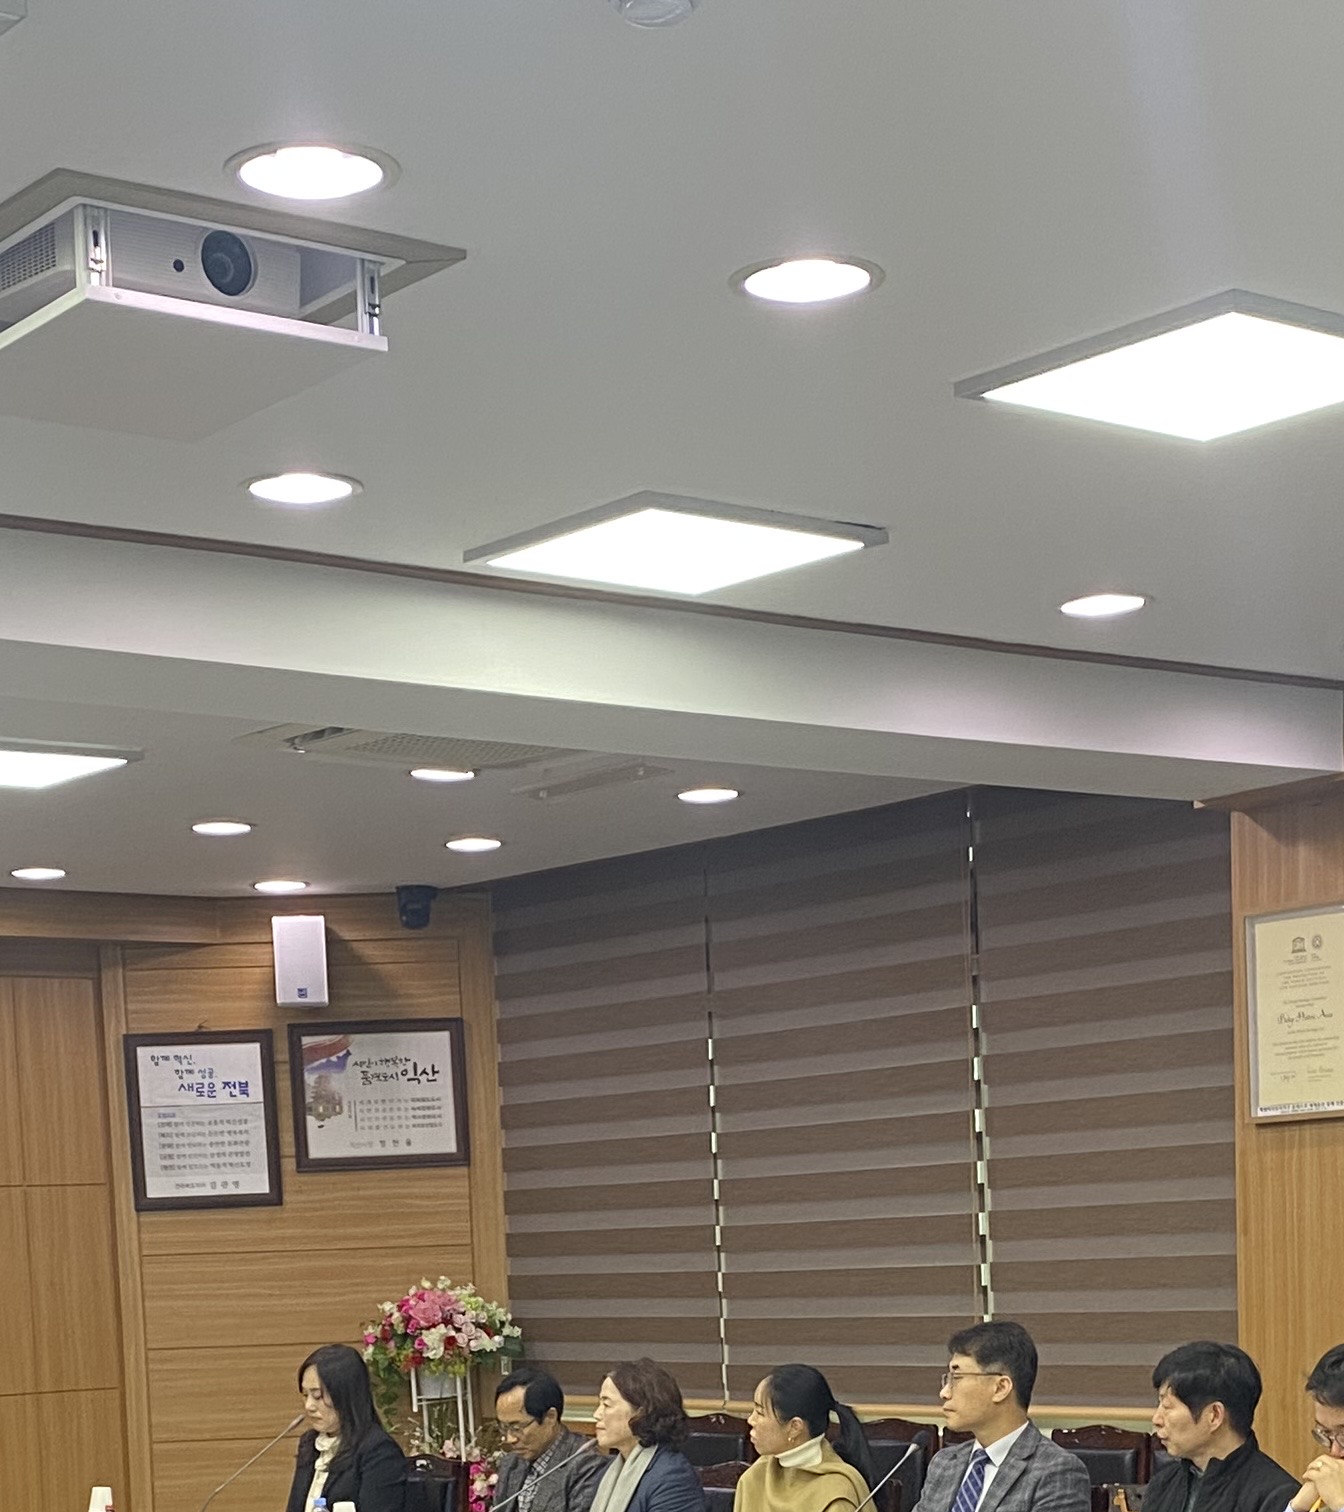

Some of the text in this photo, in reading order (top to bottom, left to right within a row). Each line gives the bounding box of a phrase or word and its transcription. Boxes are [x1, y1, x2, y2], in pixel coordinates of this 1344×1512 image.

[401, 1062, 440, 1085] 익산
[178, 1080, 249, 1098] 새로운 전북
